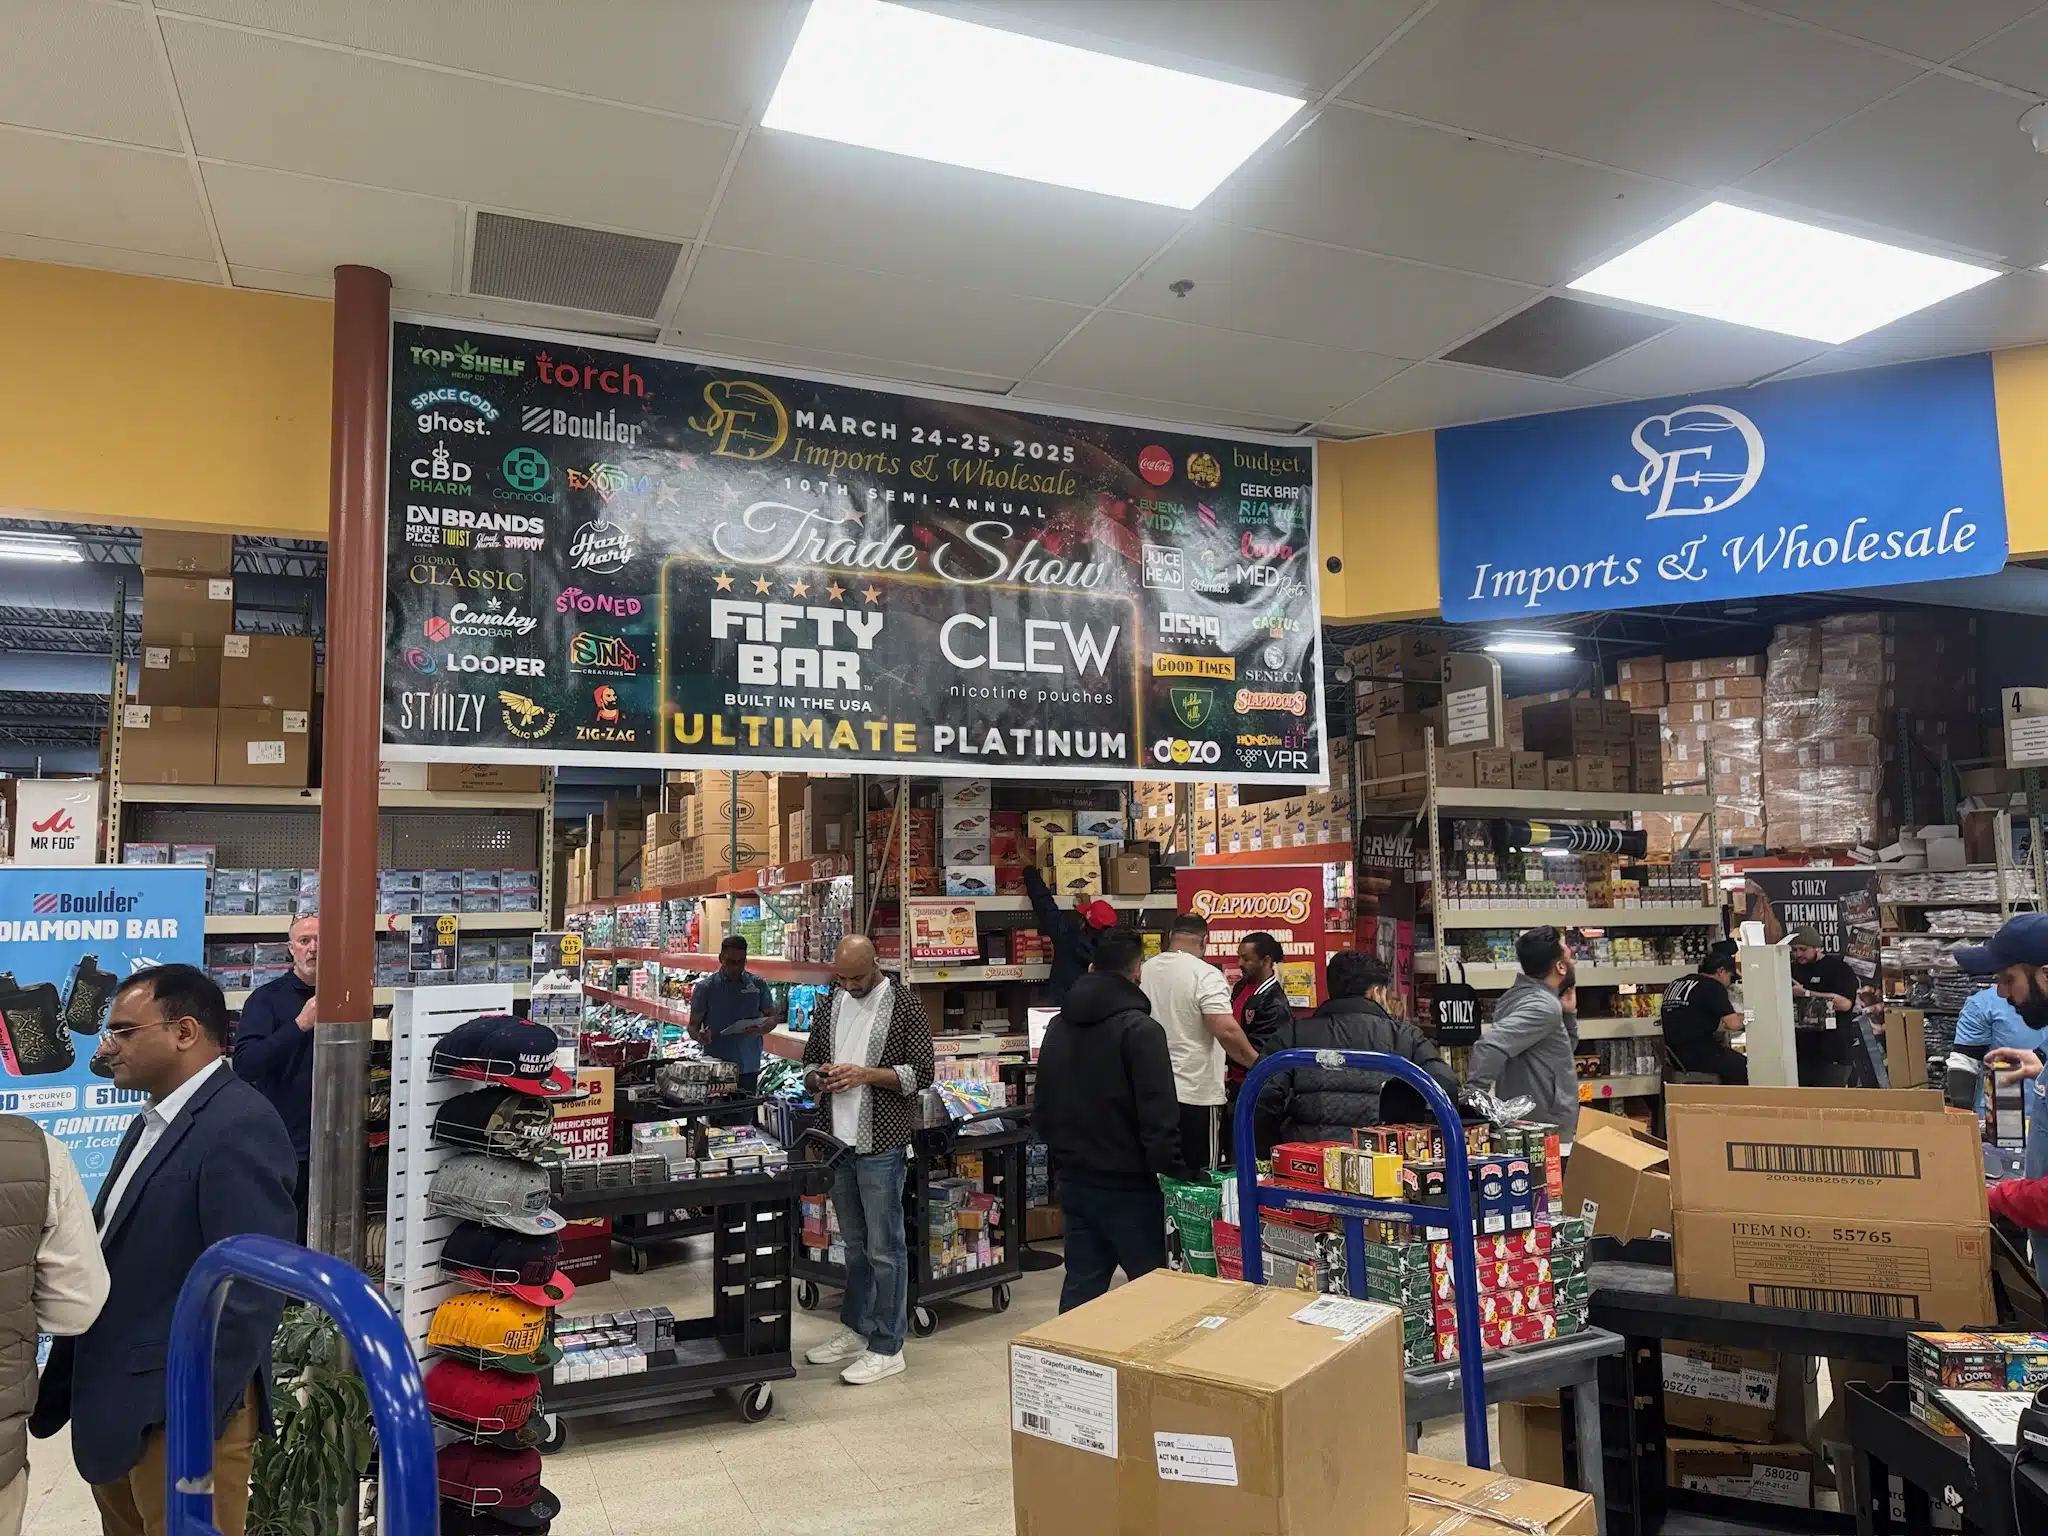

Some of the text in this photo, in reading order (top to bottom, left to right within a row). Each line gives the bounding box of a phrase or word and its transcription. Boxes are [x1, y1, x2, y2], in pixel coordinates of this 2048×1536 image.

[410, 346, 526, 377] TOP SHELF
[451, 372, 485, 382] HEMP CO
[536, 352, 645, 397] torch
[411, 388, 499, 422] SPACE GODS
[417, 411, 492, 436] ghost.
[553, 407, 642, 445] Boulder
[796, 409, 1076, 463] MARCH 24-25, 2025
[410, 455, 472, 483] CBD
[791, 438, 1077, 497] Imports & Wholesale
[410, 479, 472, 497] PHARM
[1240, 482, 1300, 500] GEEK BAR
[784, 477, 1047, 519] 10TH SEMI-ANNUAL
[1139, 498, 1187, 516] BUENA
[1142, 514, 1185, 533] VIDA
[405, 532, 440, 544] PLCE
[406, 524, 440, 535] MRKT
[442, 528, 472, 548] TWIST
[503, 535, 545, 552] SADBOY
[569, 533, 635, 556] Hazy
[712, 500, 1106, 589] Trade Show
[413, 554, 459, 566] GLOBAL
[571, 547, 635, 569] Mary
[1145, 551, 1181, 566] JUICE
[1468, 506, 1978, 608] Imports & Wholesale
[409, 564, 525, 592] CLASSIC
[1145, 567, 1182, 585] HEAD
[1236, 563, 1280, 587] MED
[1276, 576, 1307, 598] Roots
[556, 592, 642, 617] STONED
[450, 601, 538, 636] Canabzy
[1159, 611, 1221, 640] OCHO
[1251, 616, 1300, 633] CACTUS
[939, 612, 1121, 678] CLEW
[1159, 637, 1221, 646] EXTRACTS
[447, 653, 546, 678] LOOPER
[582, 668, 625, 677] CREATIONS
[738, 642, 861, 691] BAR
[1156, 656, 1194, 672] GOOD
[1443, 657, 1452, 684] 5
[1245, 670, 1304, 683] SENECA
[724, 693, 873, 713] BUILT IN THE USA
[949, 683, 1114, 706] nicotine pouches
[1236, 690, 1306, 714] SLAPWOODS
[2011, 691, 2022, 713] 4
[400, 690, 487, 733] STIIIZY
[502, 709, 557, 740] REPUBLIC BRANDS
[576, 725, 636, 742] ZIG-ZAG
[673, 712, 1127, 760] ULTIMATE PLATINUM
[1284, 735, 1308, 749] ELF
[1263, 750, 1309, 770] VPR
[30, 836, 75, 850] MR FOG
[1362, 855, 1415, 869] NATURAL LEAF
[1791, 879, 1828, 896] STIIIZY
[60, 886, 139, 913] Boulder
[1195, 890, 1308, 923] SLAPWOODS
[1784, 903, 1839, 922] PREMIUM
[0, 918, 179, 942] DIAMOND BAR
[1209, 930, 1234, 943] NEW
[1818, 921, 1839, 935] LEAF
[916, 947, 975, 956] SOLD HERE
[549, 983, 573, 991] Boulder
[518, 1052, 539, 1062] MAKE
[519, 1063, 538, 1073] GREAT
[29, 1099, 63, 1109] SCREEN
[38, 1091, 73, 1101] CURVED
[588, 1098, 602, 1108] rice
[553, 1116, 609, 1131] AMERICA'S ONLY
[85, 1134, 121, 1149] Iced
[583, 1126, 609, 1142] RICE
[566, 1143, 609, 1161] APER
[1292, 1161, 1318, 1174] Zen
[1268, 1226, 1310, 1247] GAMBLER
[1732, 1222, 1893, 1244] ITEM NO: 55765
[1787, 1250, 1825, 1258] QUANTITY
[1040, 1357, 1104, 1379] Grapefruit Refresher
[1662, 1379, 1698, 1396] 57250
[1957, 1372, 1993, 1384] LOOPER
[1157, 1440, 1175, 1448] STORE
[1159, 1453, 1169, 1461] ACT
[1160, 1467, 1173, 1475] BOX
[1765, 1467, 1800, 1482] 58020
